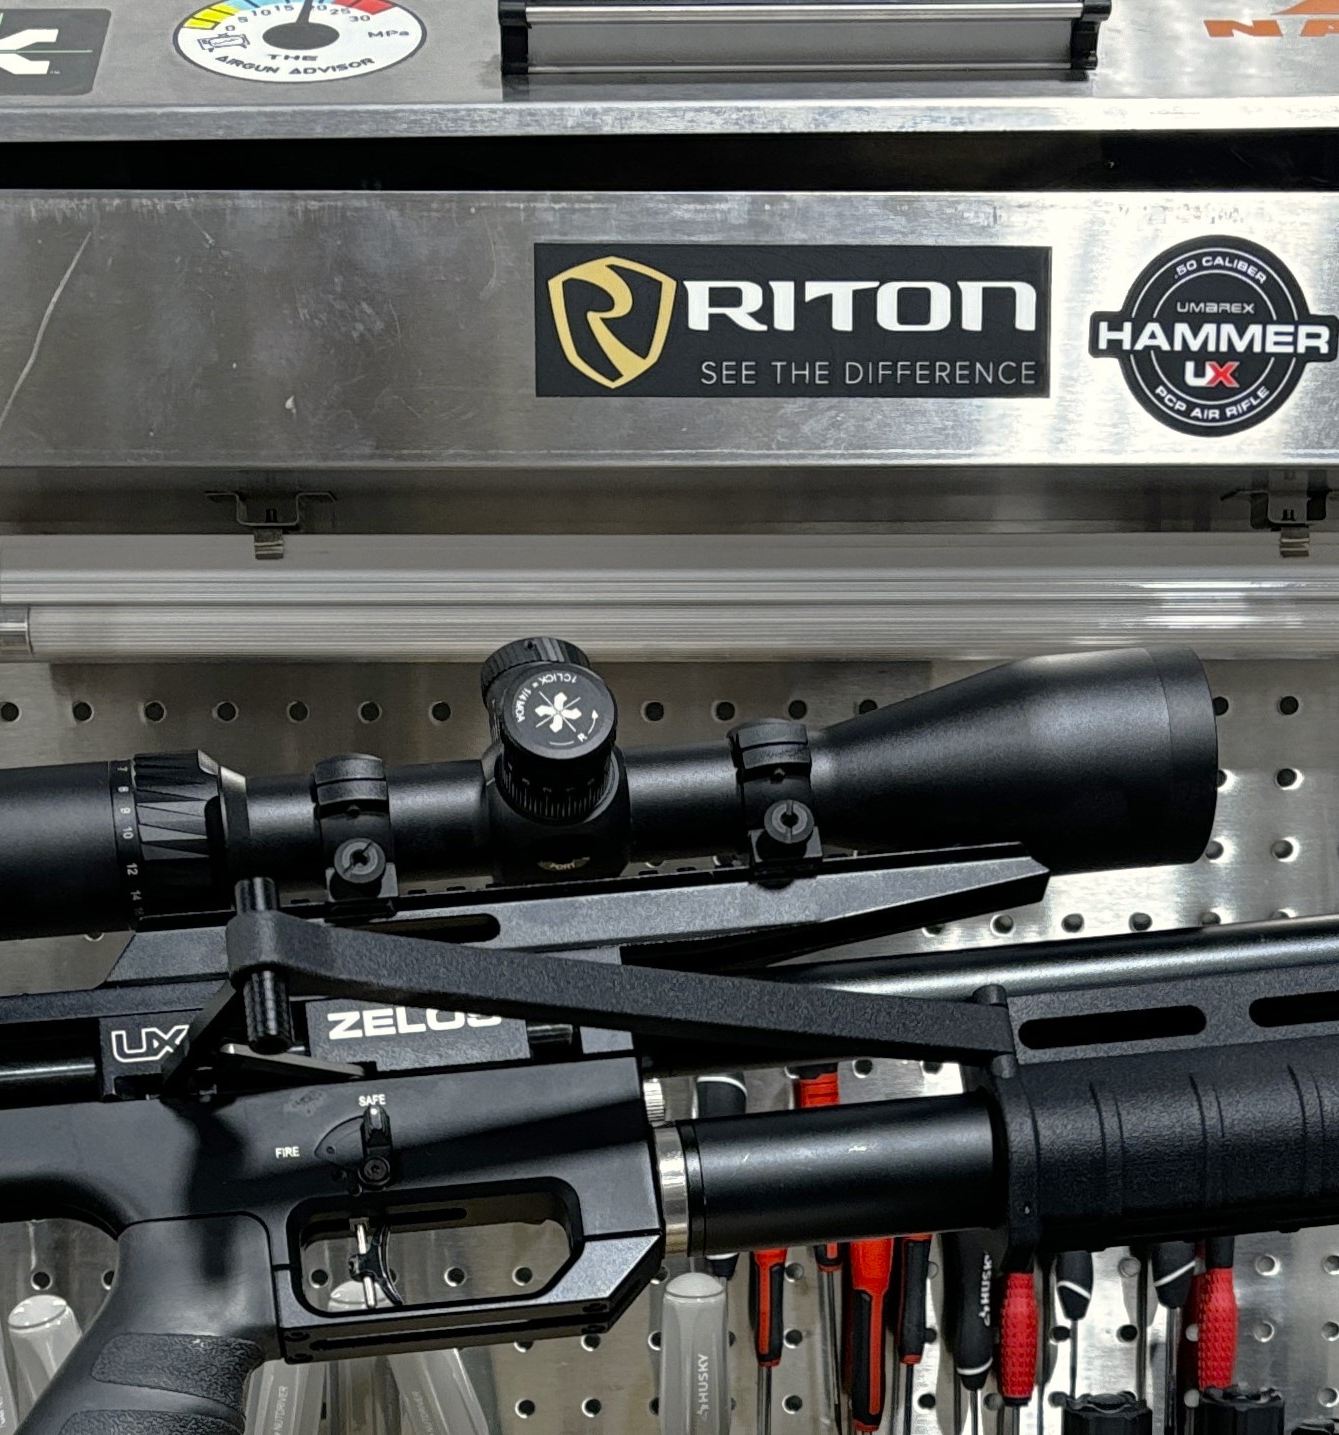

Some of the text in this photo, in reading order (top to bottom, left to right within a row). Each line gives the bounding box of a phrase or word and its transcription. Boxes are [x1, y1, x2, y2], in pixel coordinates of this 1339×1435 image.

[238, 16, 249, 24] 5
[252, 9, 271, 17] 10
[349, 14, 371, 22] 30
[367, 30, 410, 39] MPa
[214, 54, 376, 75] AIRGUN ADVISOR
[267, 54, 318, 62] THE
[1173, 256, 1268, 285] .50 CALIBER
[683, 279, 1038, 332] RITON
[1097, 320, 1331, 354] HAMMER
[700, 360, 1037, 385] SEE THE DIFFERENCE
[1184, 360, 1240, 388] UX
[1154, 384, 1271, 420] PCP AIR RIFLE
[122, 825, 134, 840] 10
[126, 862, 139, 876] 12
[130, 889, 143, 901] 14
[110, 1023, 191, 1064] UX
[358, 1093, 387, 1107] SAFE
[275, 1146, 300, 1159] FIRE
[697, 1353, 709, 1403] HUSKY
